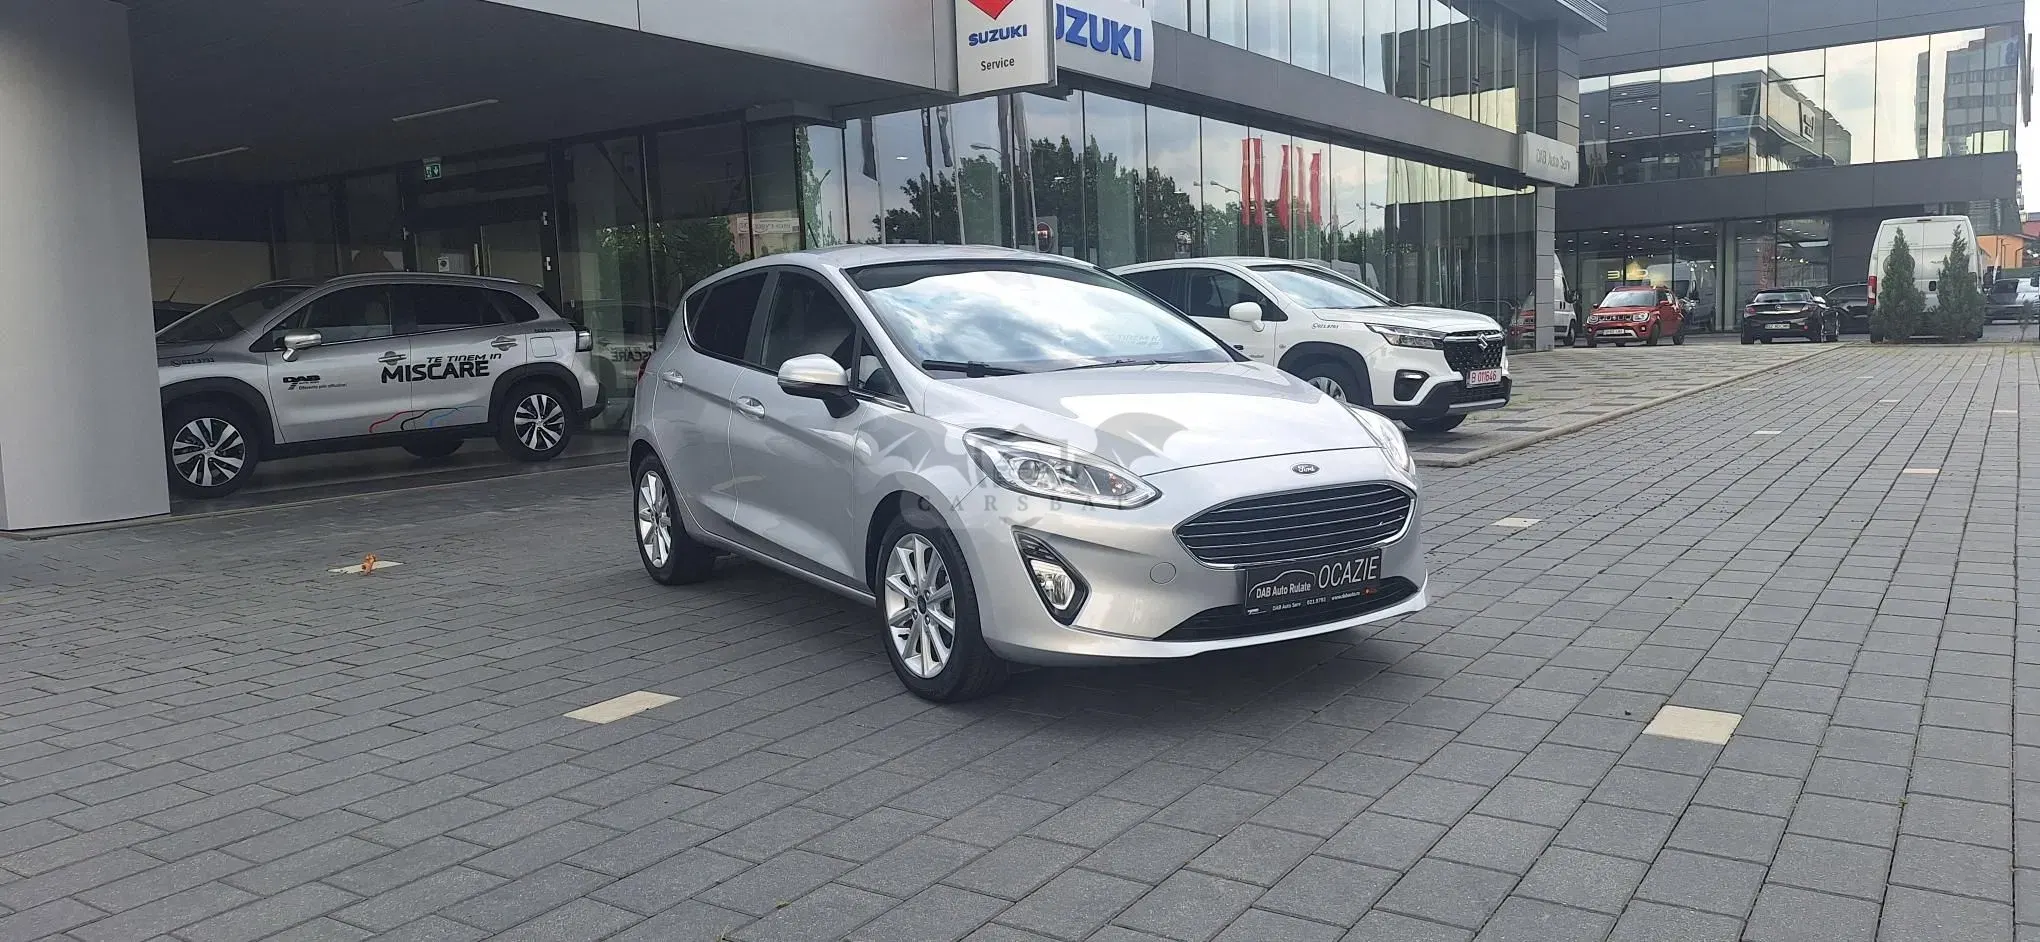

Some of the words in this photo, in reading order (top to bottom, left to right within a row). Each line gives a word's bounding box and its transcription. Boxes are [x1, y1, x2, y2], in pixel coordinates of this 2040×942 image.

[968, 24, 1028, 47] SUZUKI
[980, 57, 1015, 71] Service
[282, 375, 321, 383] DAB
[381, 360, 490, 384] MISCARE
[1471, 372, 1477, 383] B
[1318, 555, 1380, 589] OCAZIE
[1256, 587, 1271, 599] DAB
[1272, 585, 1288, 597] Auto
[1289, 582, 1312, 594] Rulate
